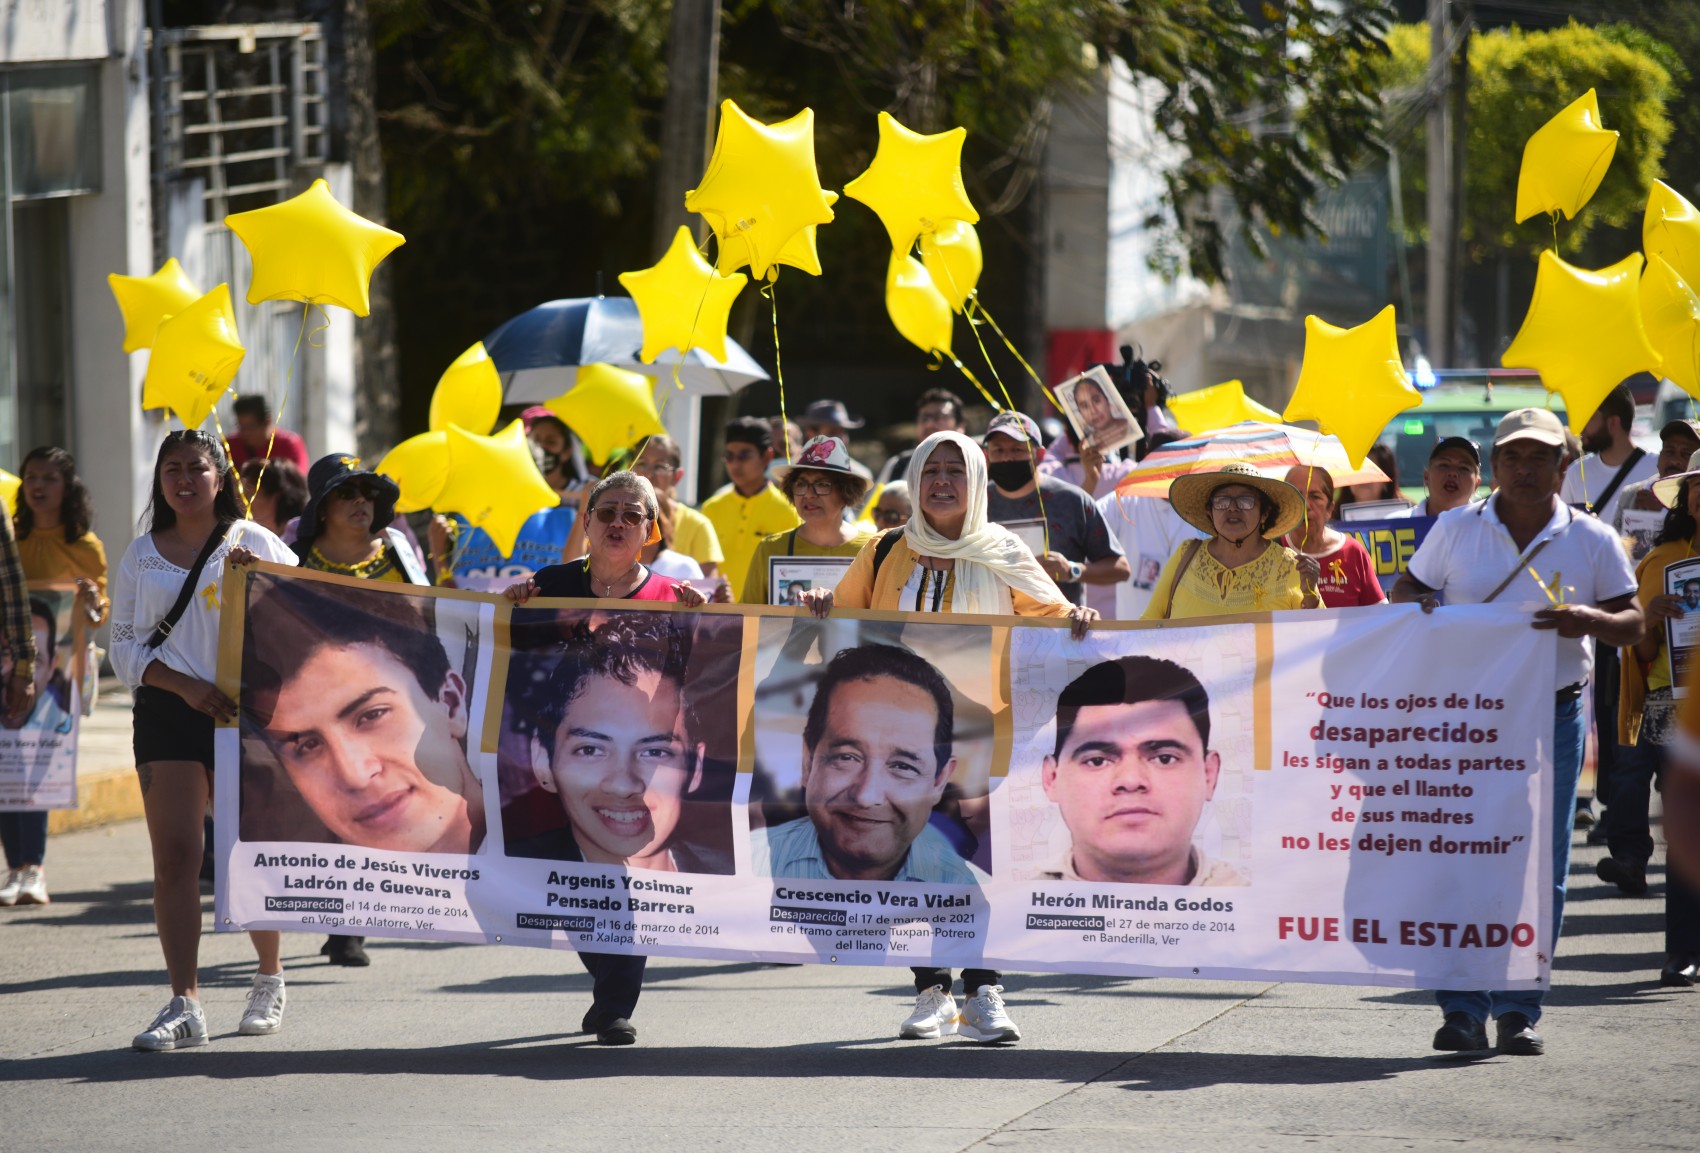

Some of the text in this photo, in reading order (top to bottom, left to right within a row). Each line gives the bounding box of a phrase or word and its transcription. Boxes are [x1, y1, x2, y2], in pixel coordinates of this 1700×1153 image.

[1345, 528, 1415, 575] NDE
[1361, 693, 1389, 709] los
[1396, 694, 1437, 713] ojos
[1443, 693, 1469, 710] de
[1475, 693, 1505, 710] los
[1310, 720, 1498, 748] desaparecidos
[1283, 751, 1526, 775] les sigan a todas partes
[1330, 780, 1473, 800] y que el llanto
[1331, 806, 1474, 825] de sus madres
[1281, 835, 1310, 850] no
[1318, 832, 1351, 851] les
[1358, 834, 1422, 856] dejen
[254, 853, 480, 881] Antonio de Jesús Viveros
[284, 875, 451, 899] Ladrón de Guevara
[547, 871, 693, 895] Argenis Yosimar
[267, 898, 468, 917] Desaparecido el 14 de marzo de 2014
[547, 893, 695, 914] Pensado Barrera
[776, 887, 971, 908] Crescencio Vera Vidal
[1031, 892, 1234, 913] Herón Miranda Godos
[302, 916, 315, 924] en
[318, 915, 345, 927] Vega
[349, 916, 362, 926] de
[519, 916, 719, 935] Desaparecido el 16 de marzo de 2014
[773, 909, 845, 923] Desaparecido
[848, 914, 858, 924] el
[862, 914, 873, 924] 17
[876, 915, 890, 925] de
[932, 913, 947, 923] de
[950, 913, 975, 924] 2021
[1028, 916, 1235, 933] Desaparecido el 27 de marzo de 2014
[580, 933, 593, 941] en
[771, 924, 976, 939] en el tramo carretero Tuxpan-Potrero
[1082, 934, 1096, 942] en
[1278, 916, 1535, 949] FUE EL ESTADO
[835, 940, 852, 950] del
